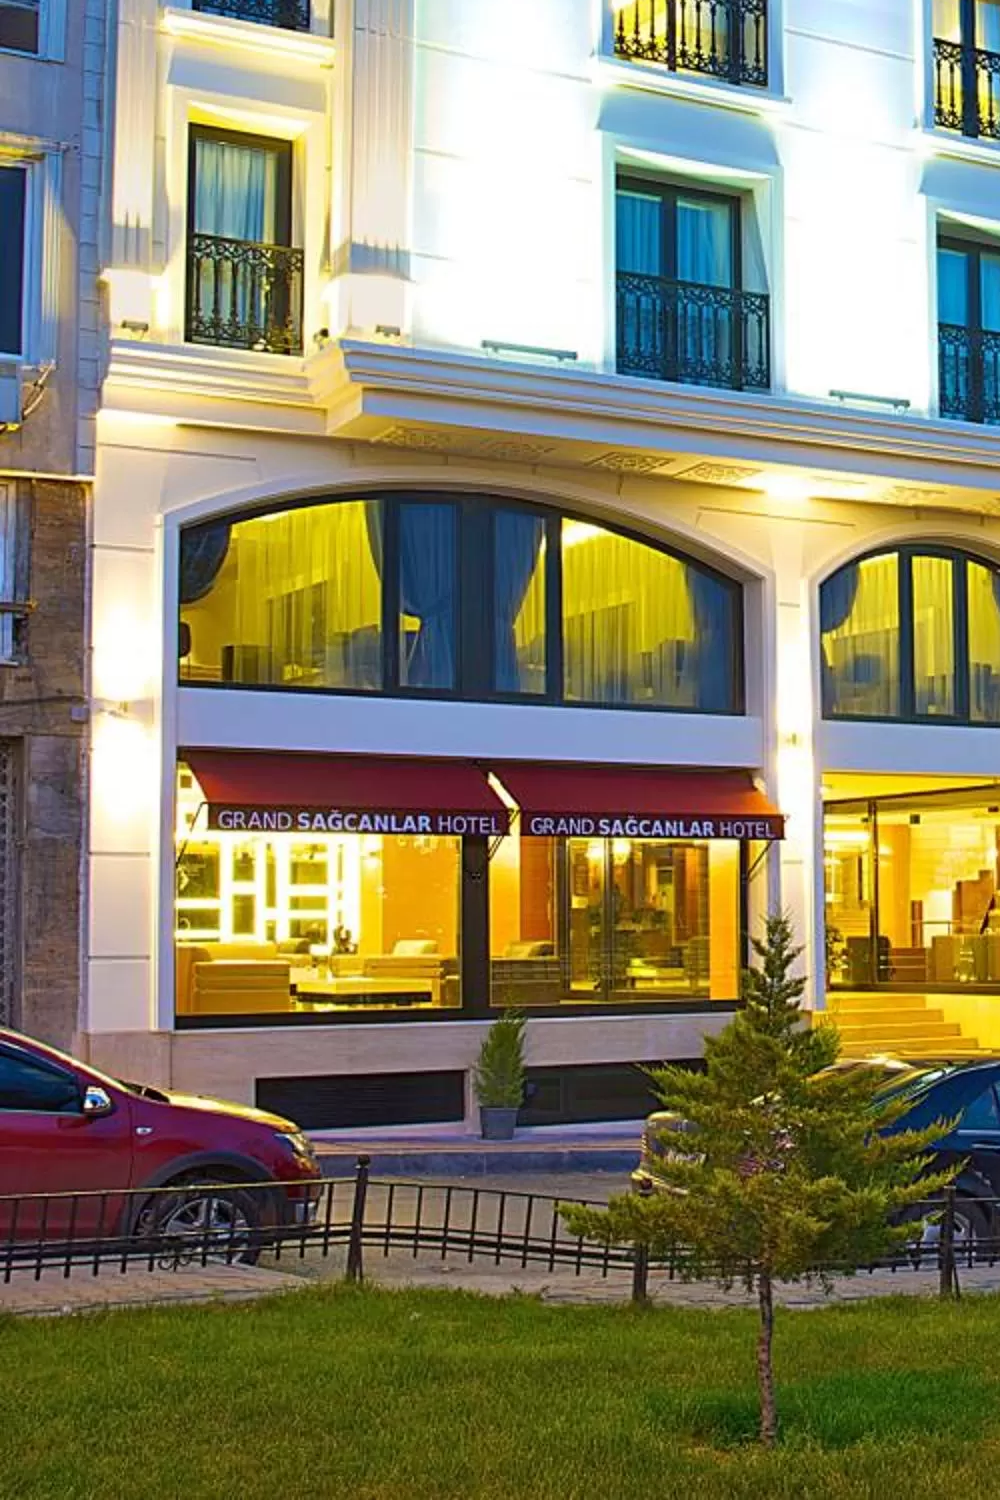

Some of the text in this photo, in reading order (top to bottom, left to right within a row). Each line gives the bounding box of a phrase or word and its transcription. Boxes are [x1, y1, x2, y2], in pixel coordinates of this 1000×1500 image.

[217, 809, 501, 834] GRAND SAĞCANLAR HOTEL
[530, 815, 776, 839] GRAND SAĞCANLAR HOTEL
